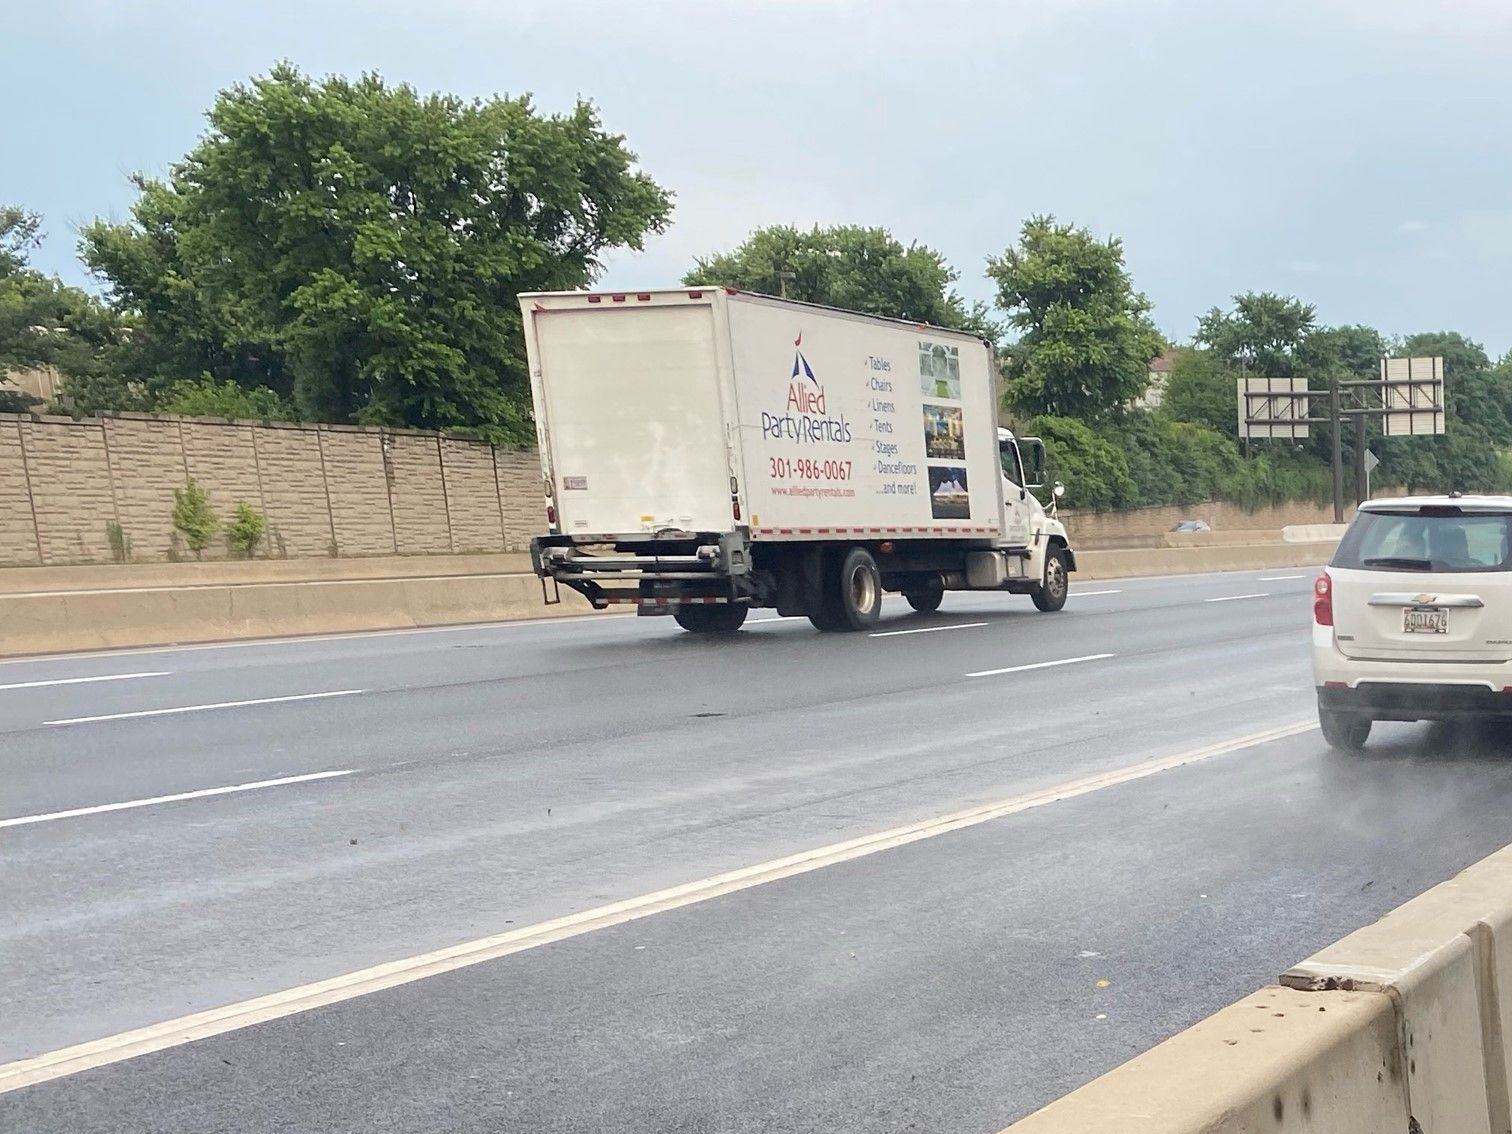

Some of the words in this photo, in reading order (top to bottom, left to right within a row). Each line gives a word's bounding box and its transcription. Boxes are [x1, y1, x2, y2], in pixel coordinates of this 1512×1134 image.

[869, 356, 891, 371] Tables
[871, 377, 892, 392] Chairs
[787, 382, 826, 415] Allied
[873, 398, 895, 413] Linens
[874, 418, 893, 433] Tents
[876, 440, 898, 457] Stages
[770, 457, 852, 480] 301-986-0067
[878, 460, 917, 475] Dancefloors
[898, 481, 917, 495] more!
